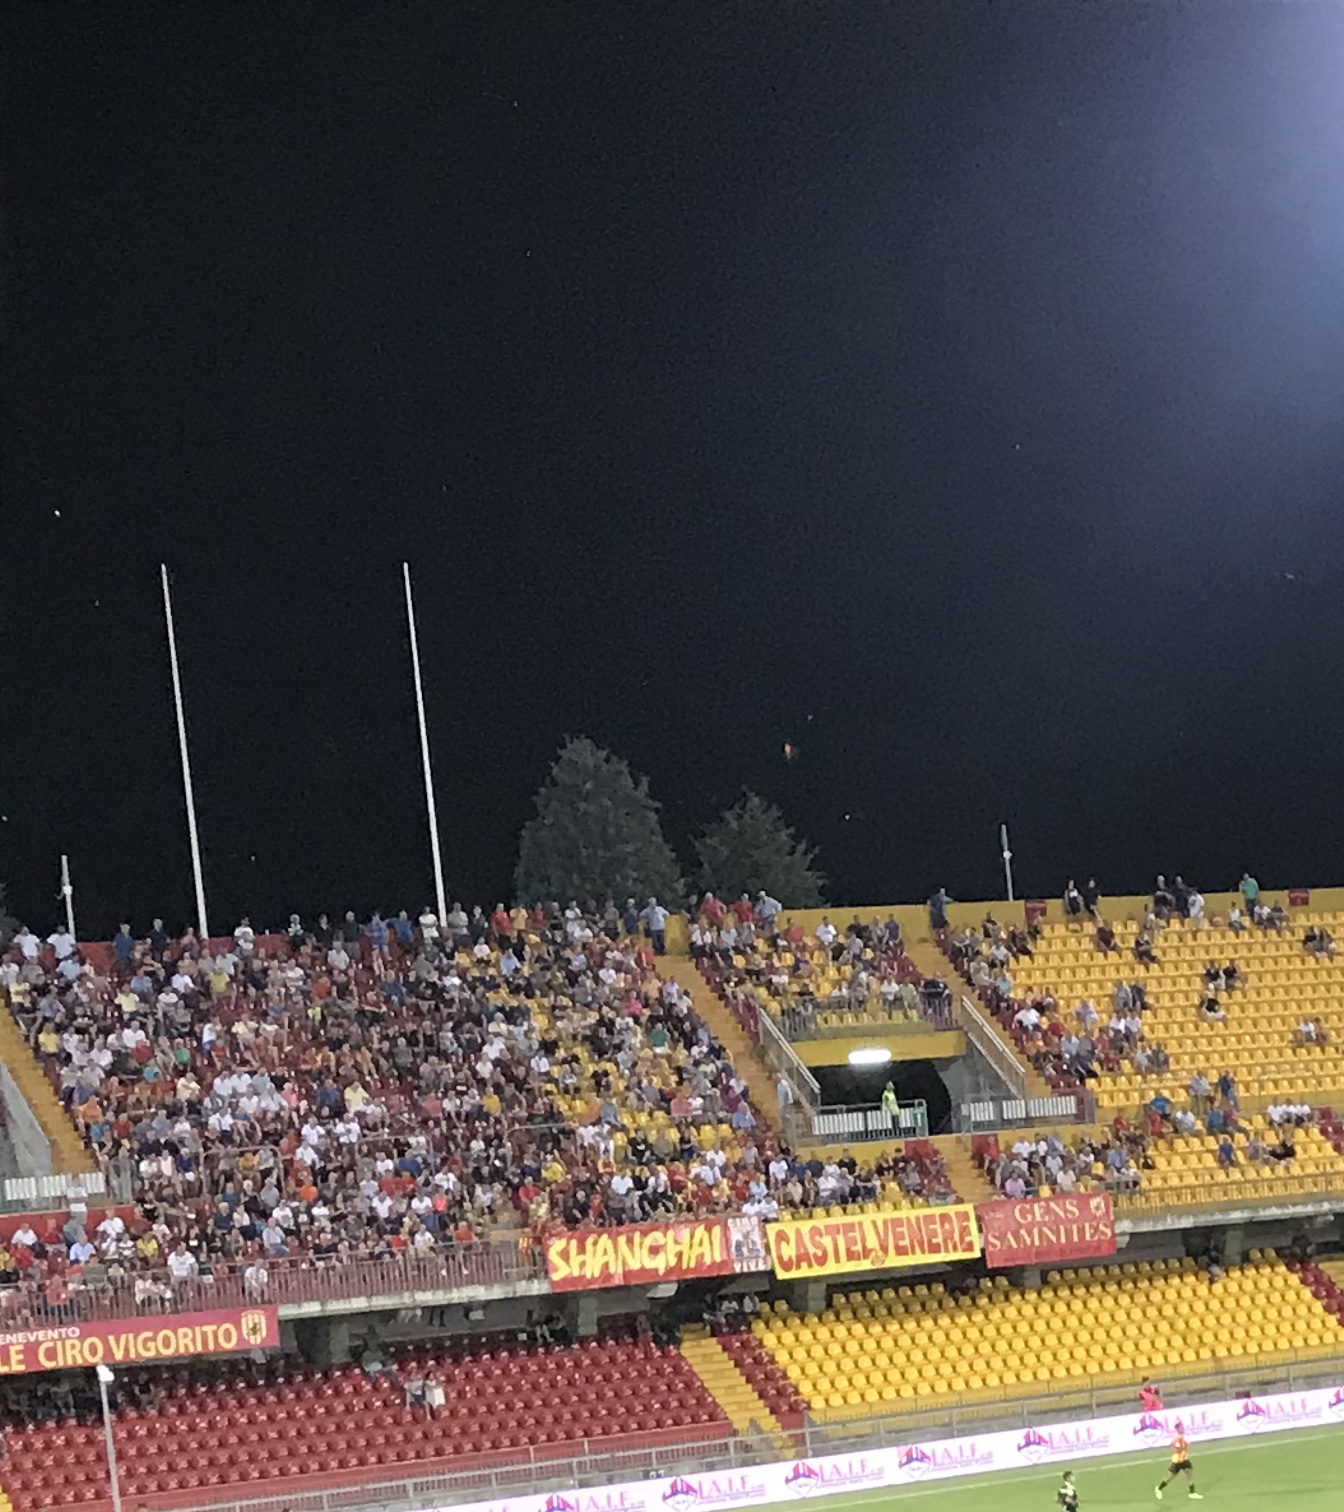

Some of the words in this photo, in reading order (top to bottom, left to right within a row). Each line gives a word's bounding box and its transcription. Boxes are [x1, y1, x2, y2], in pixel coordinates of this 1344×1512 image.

[987, 1220, 1114, 1251] SAMNITES
[1013, 1200, 1080, 1225] GENS
[548, 1224, 722, 1282] SHANGHAI
[774, 1212, 976, 1273] CASTELVENERE
[38, 1336, 104, 1369] CIRO
[107, 1322, 238, 1361] VIGORITO
